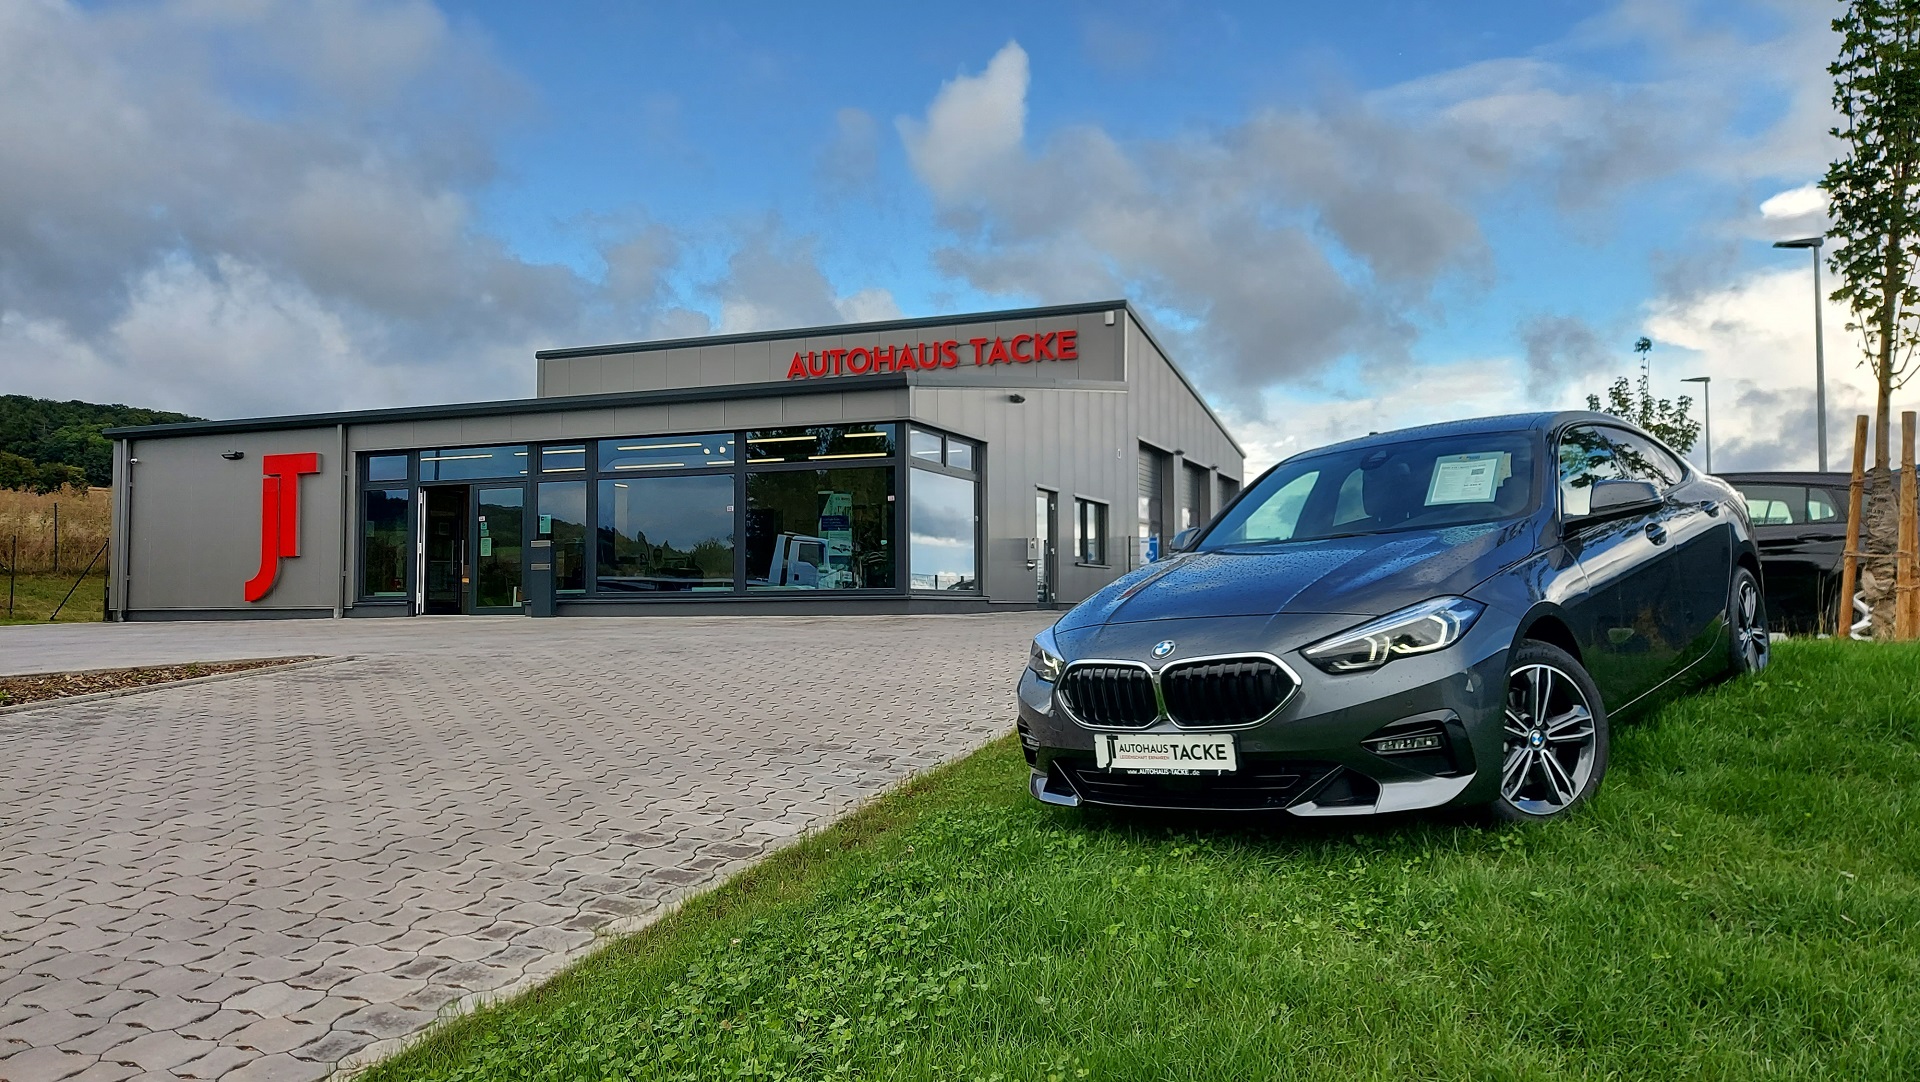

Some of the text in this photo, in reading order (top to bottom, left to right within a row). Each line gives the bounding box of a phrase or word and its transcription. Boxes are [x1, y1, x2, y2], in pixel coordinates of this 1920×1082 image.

[786, 329, 1078, 380] AUTOHAUS TACKE
[1119, 744, 1227, 760] AUTOHAUS TACKE
